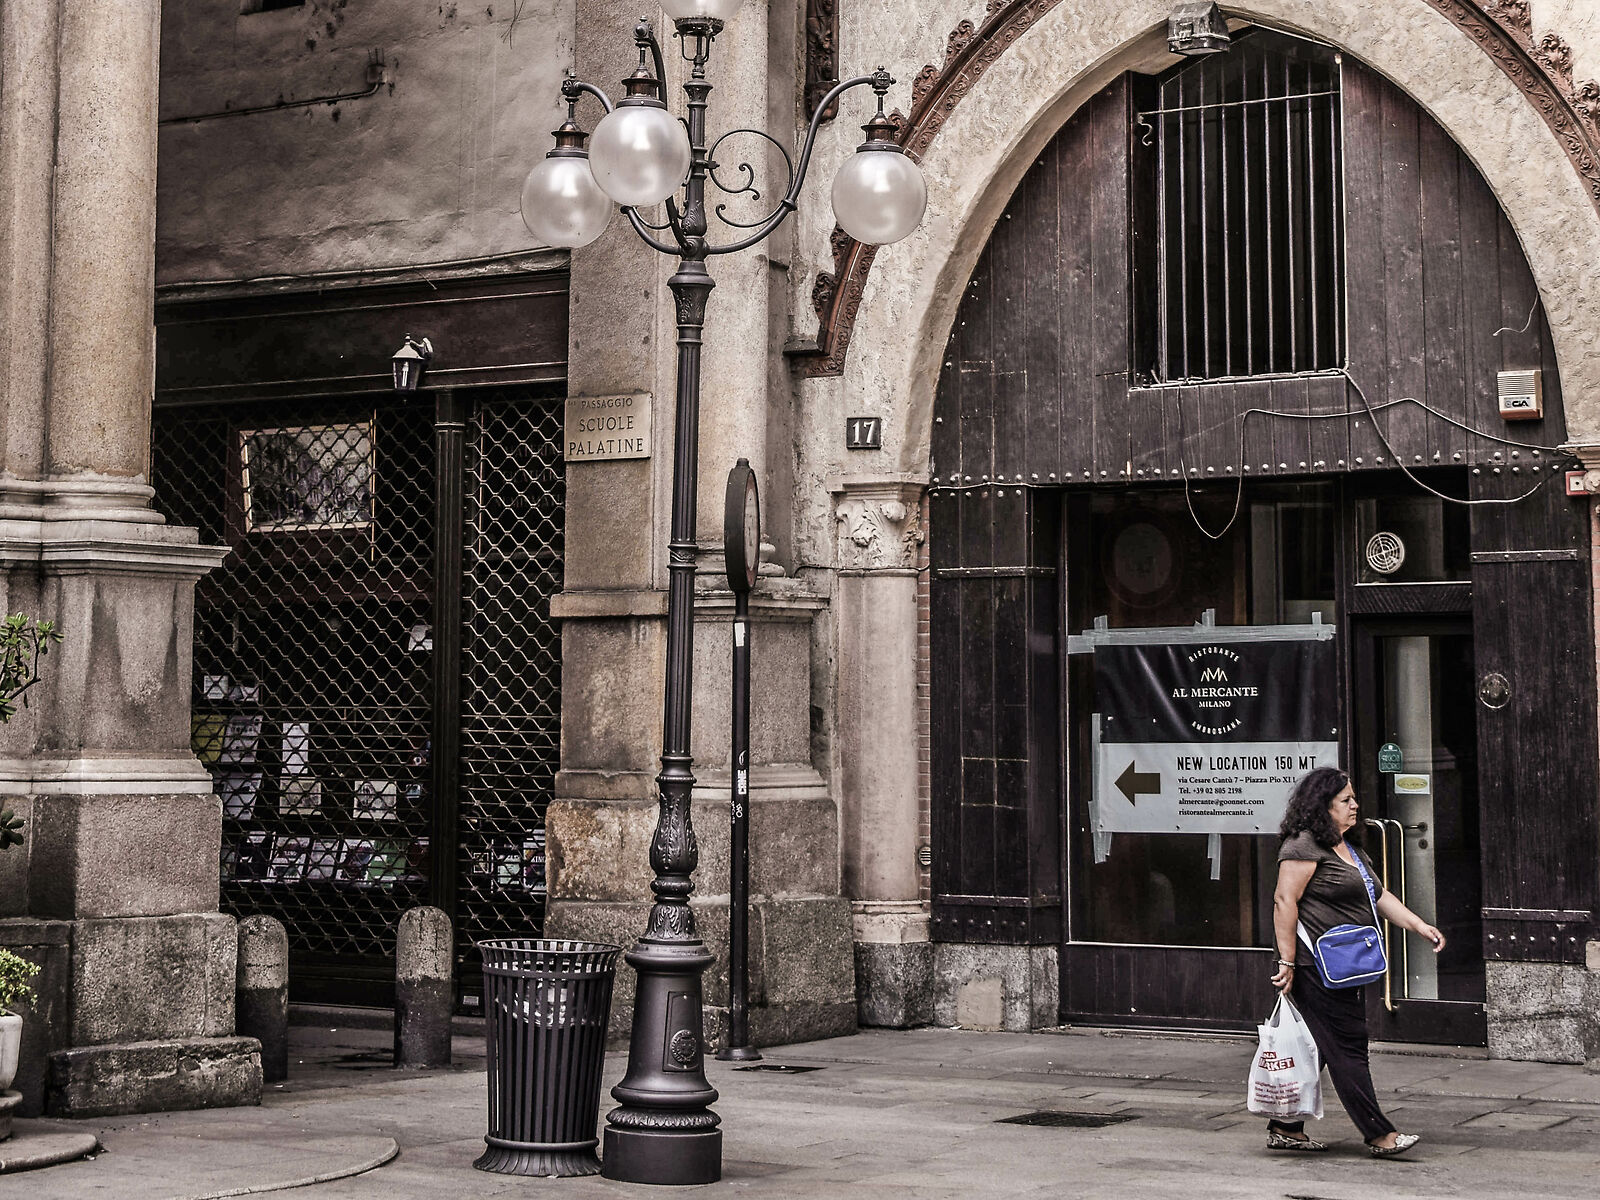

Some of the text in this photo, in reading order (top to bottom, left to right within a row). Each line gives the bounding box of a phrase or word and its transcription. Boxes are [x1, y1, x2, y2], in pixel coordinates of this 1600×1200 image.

[581, 397, 633, 409] PASSAGGIO
[579, 415, 634, 432] SCUOLE
[852, 420, 875, 445] 17
[569, 438, 644, 456] PALATINE
[1188, 646, 1240, 663] RISTORANTE
[1172, 686, 1259, 698] AL MERCANTE
[1198, 700, 1231, 708] MILANO
[1191, 718, 1242, 735] AMBROSIANA
[1177, 756, 1316, 771] NEW LOCATION 150 MT
[1189, 776, 1211, 784] Cesare
[1212, 776, 1233, 784] Cantù
[1245, 776, 1268, 784] Piazza
[1269, 776, 1282, 784] Pio
[1178, 798, 1265, 807] almercante@goonnet.com
